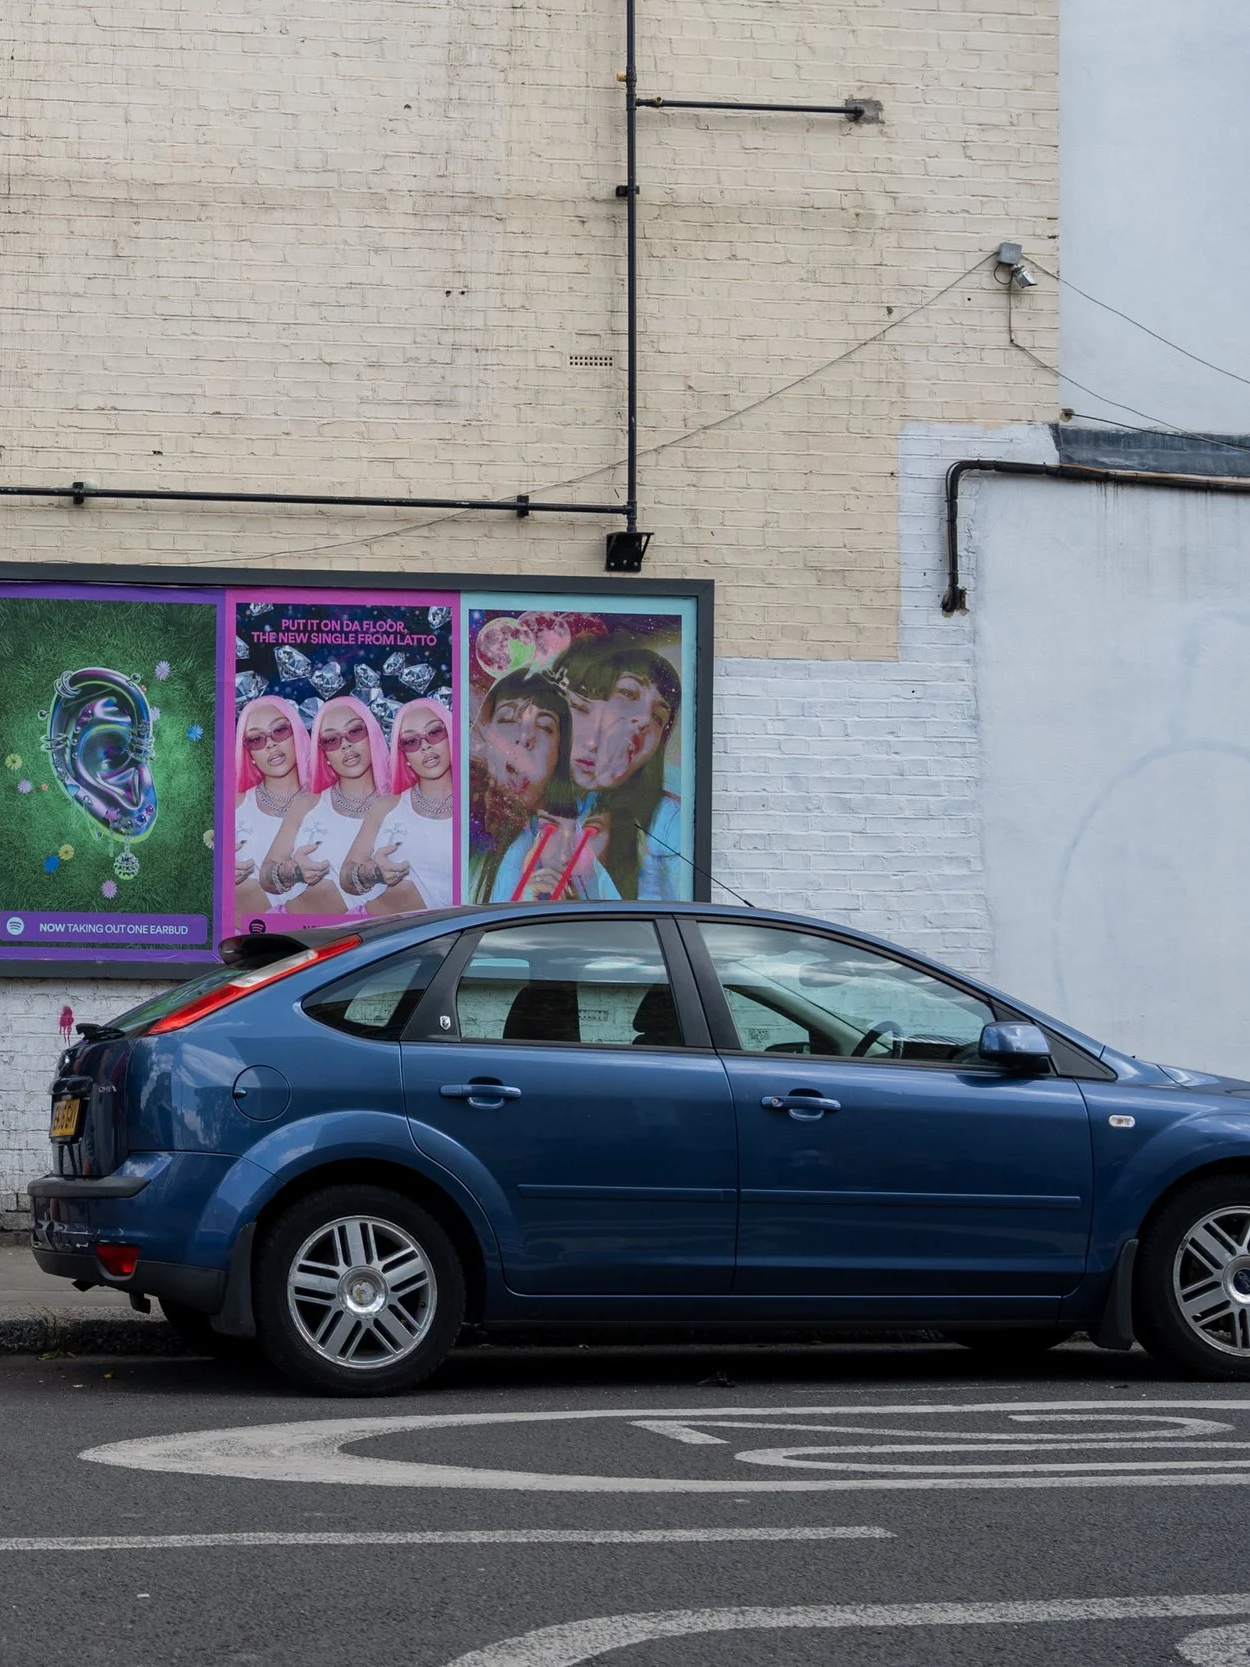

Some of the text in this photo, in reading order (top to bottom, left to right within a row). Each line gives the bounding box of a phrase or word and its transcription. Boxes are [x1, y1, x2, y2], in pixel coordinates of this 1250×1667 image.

[281, 619, 408, 634] PUT IT ON DA FLOOR,
[252, 632, 437, 646] THE NEW SINGLE FROM LATTO
[39, 923, 188, 935] NOW TAKING OUT ONE EARBUD
